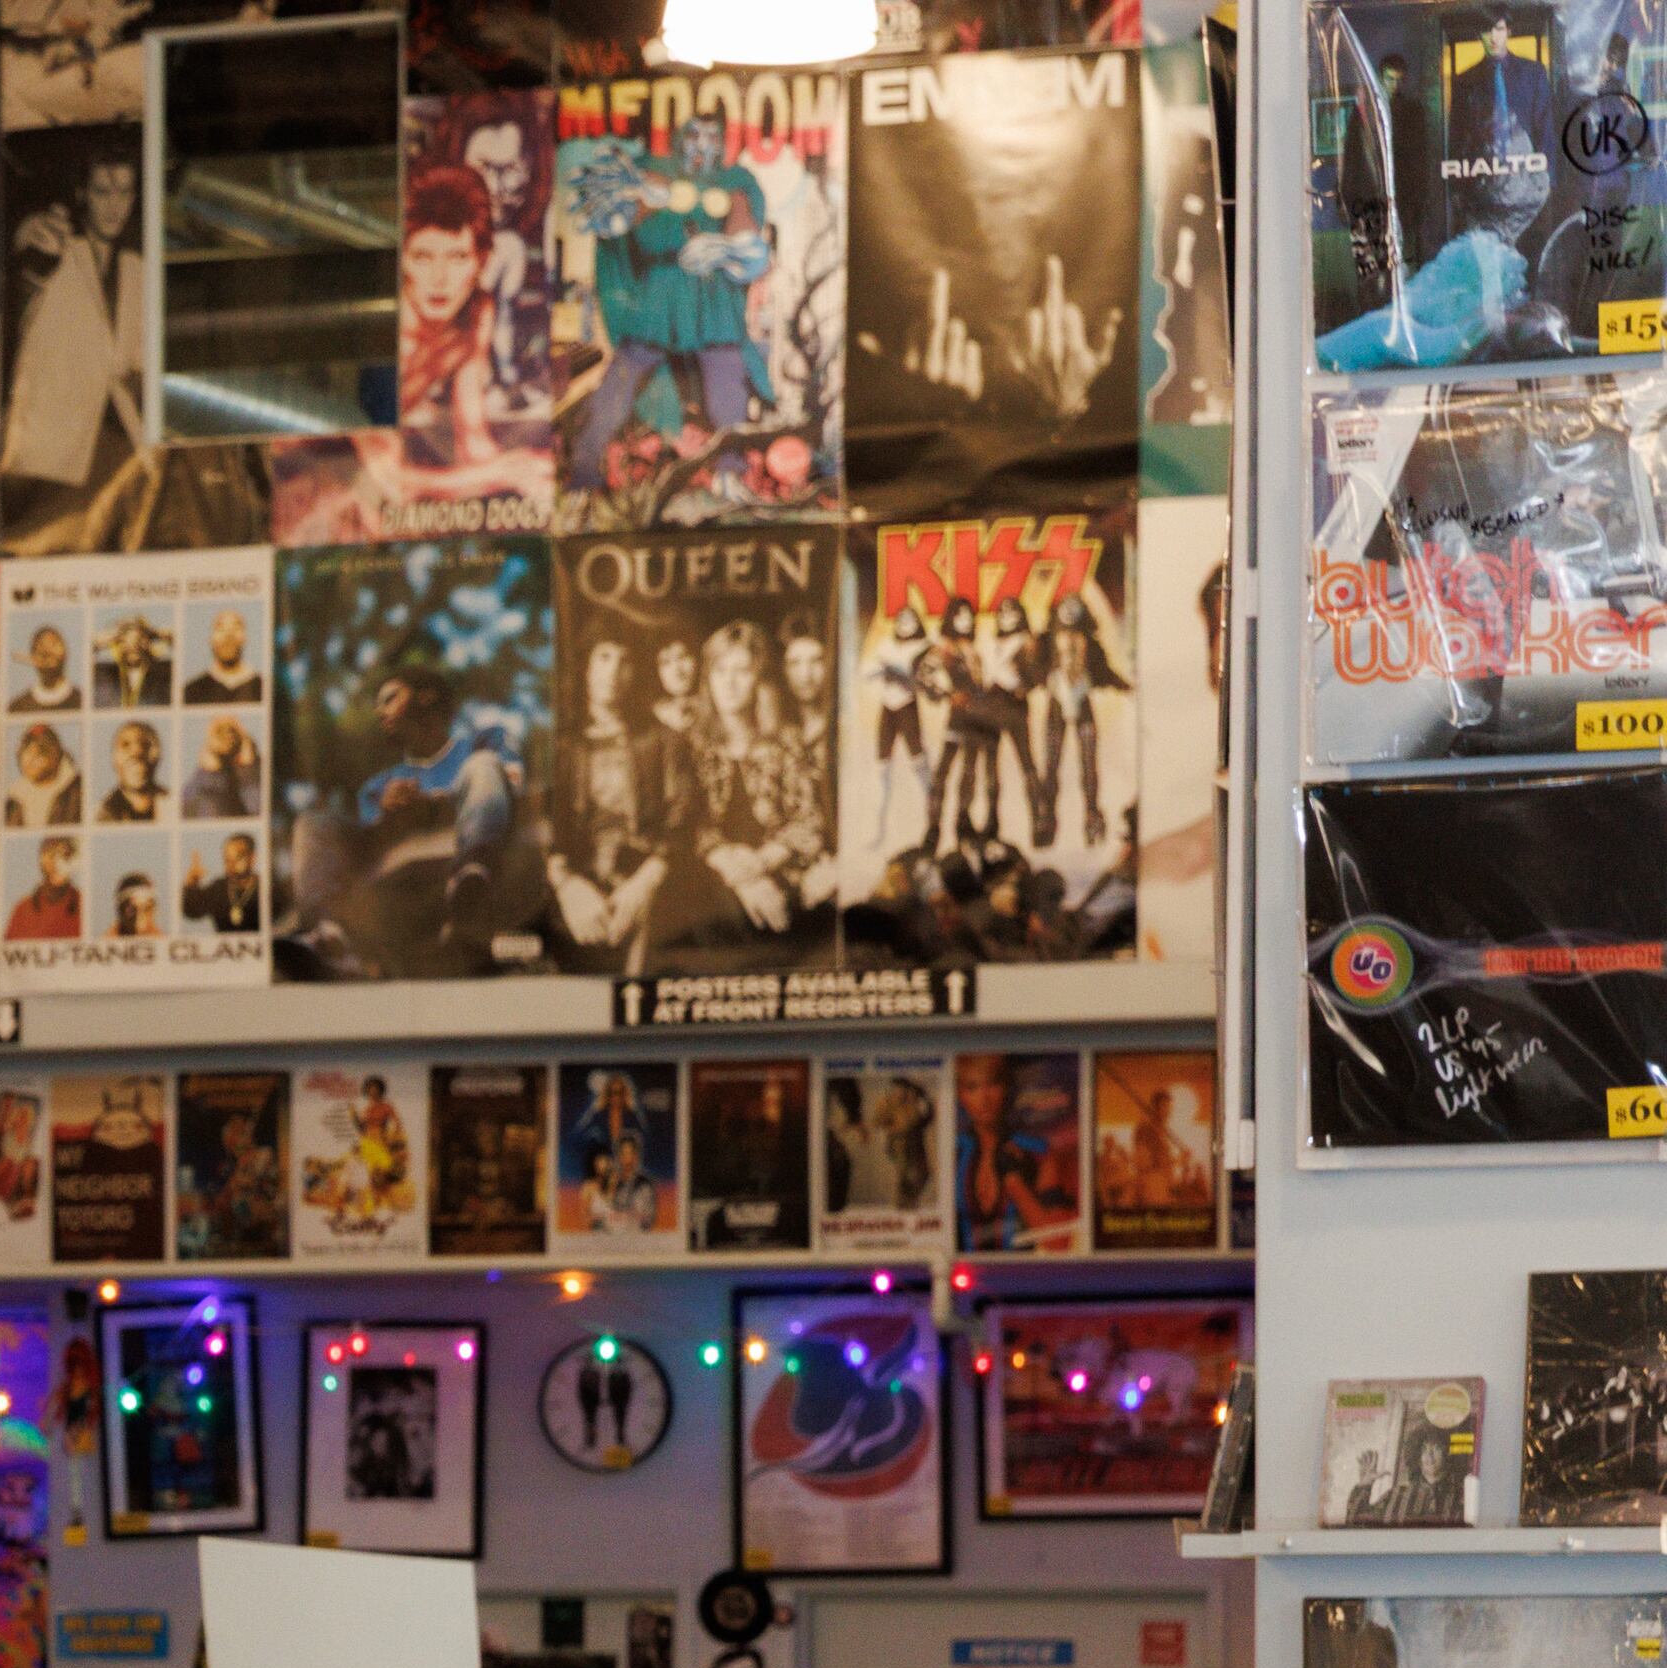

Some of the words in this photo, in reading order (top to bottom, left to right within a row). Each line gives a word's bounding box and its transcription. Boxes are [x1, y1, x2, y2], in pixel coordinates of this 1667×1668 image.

[863, 52, 1125, 127] EMM
[1580, 109, 1630, 155] UK
[1441, 152, 1547, 179] RIALTO
[1583, 205, 1640, 231] DISC
[1591, 235, 1611, 250] IS
[381, 501, 484, 535] DIAMOND
[577, 541, 815, 606] QUEEN
[878, 514, 1103, 616] KISS
[5, 939, 155, 969] WU-TANG
[170, 937, 263, 964] CLAN
[656, 977, 779, 1000] POSTERS
[786, 970, 931, 996] AVAILABLE
[653, 1001, 688, 1023] AT
[693, 998, 779, 1021] FRONT
[786, 994, 933, 1019] REGISTERS
[1418, 1022, 1442, 1054] 2
[1442, 1007, 1468, 1045] LP
[56, 1206, 134, 1230] TOTORO
